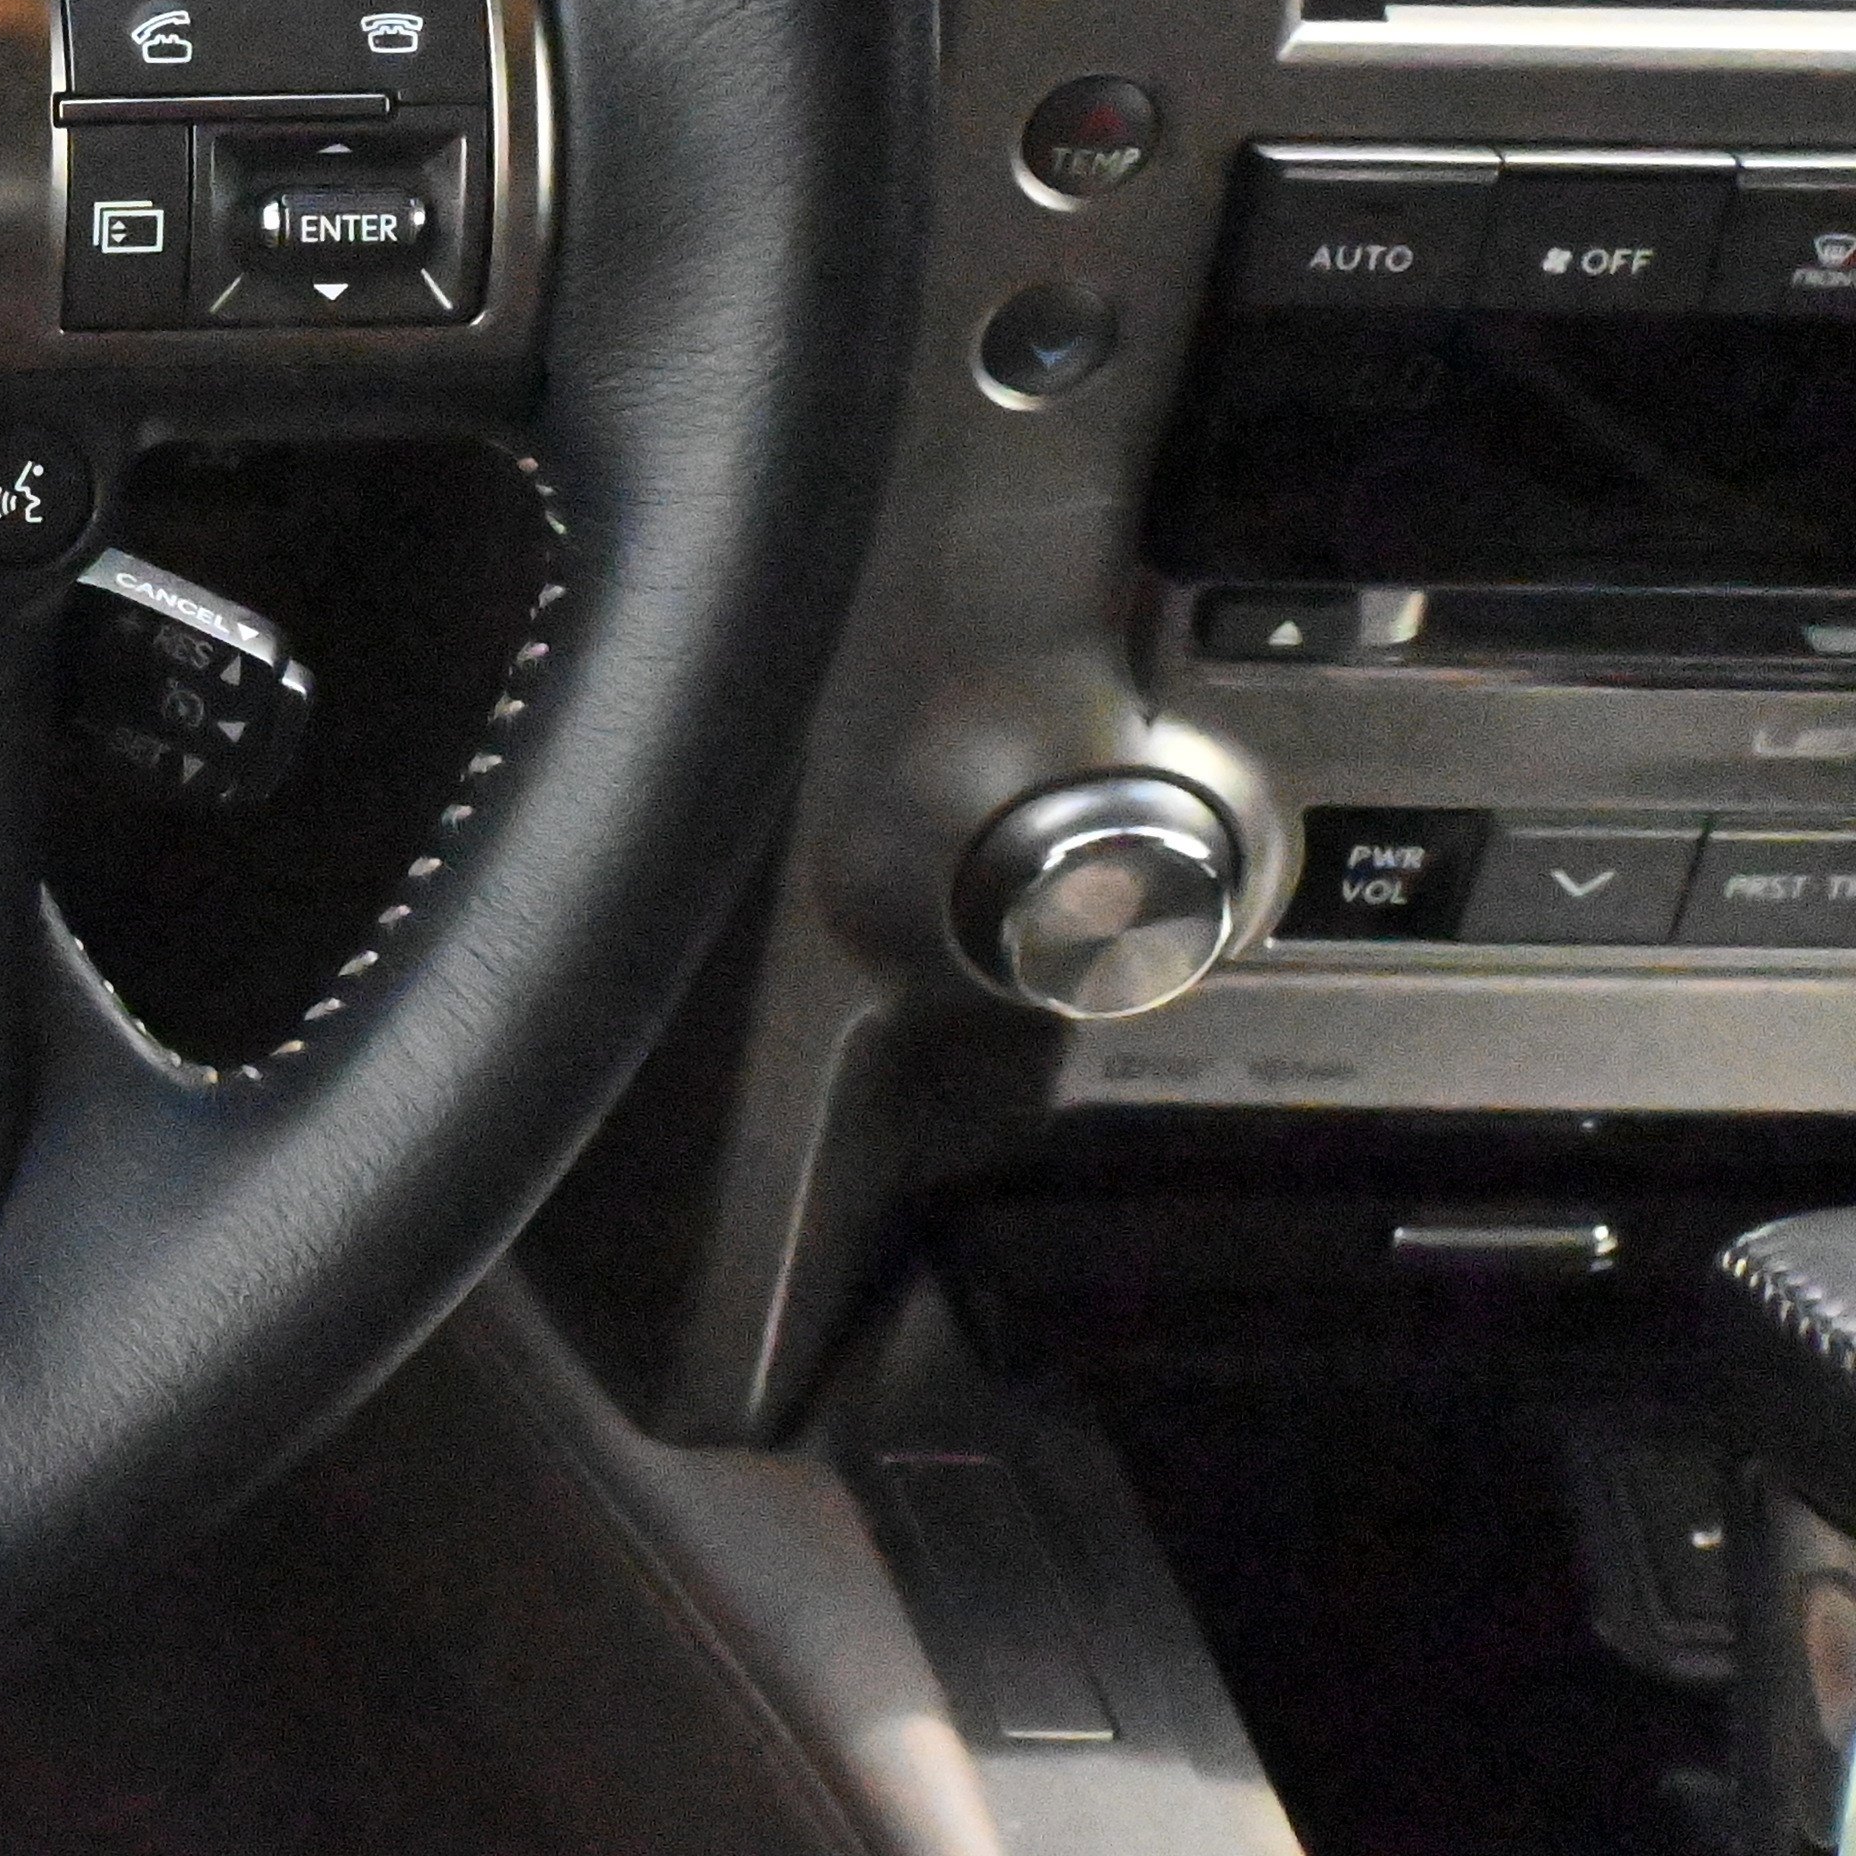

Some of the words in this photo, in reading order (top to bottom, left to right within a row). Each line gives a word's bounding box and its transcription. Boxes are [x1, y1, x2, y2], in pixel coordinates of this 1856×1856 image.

[301, 213, 397, 243] ENTER
[1310, 244, 1414, 273] AUTO
[1581, 248, 1653, 275] OFF
[116, 572, 231, 634] CANCEL
[1349, 845, 1425, 869] PWR
[1342, 880, 1407, 904] VOL
